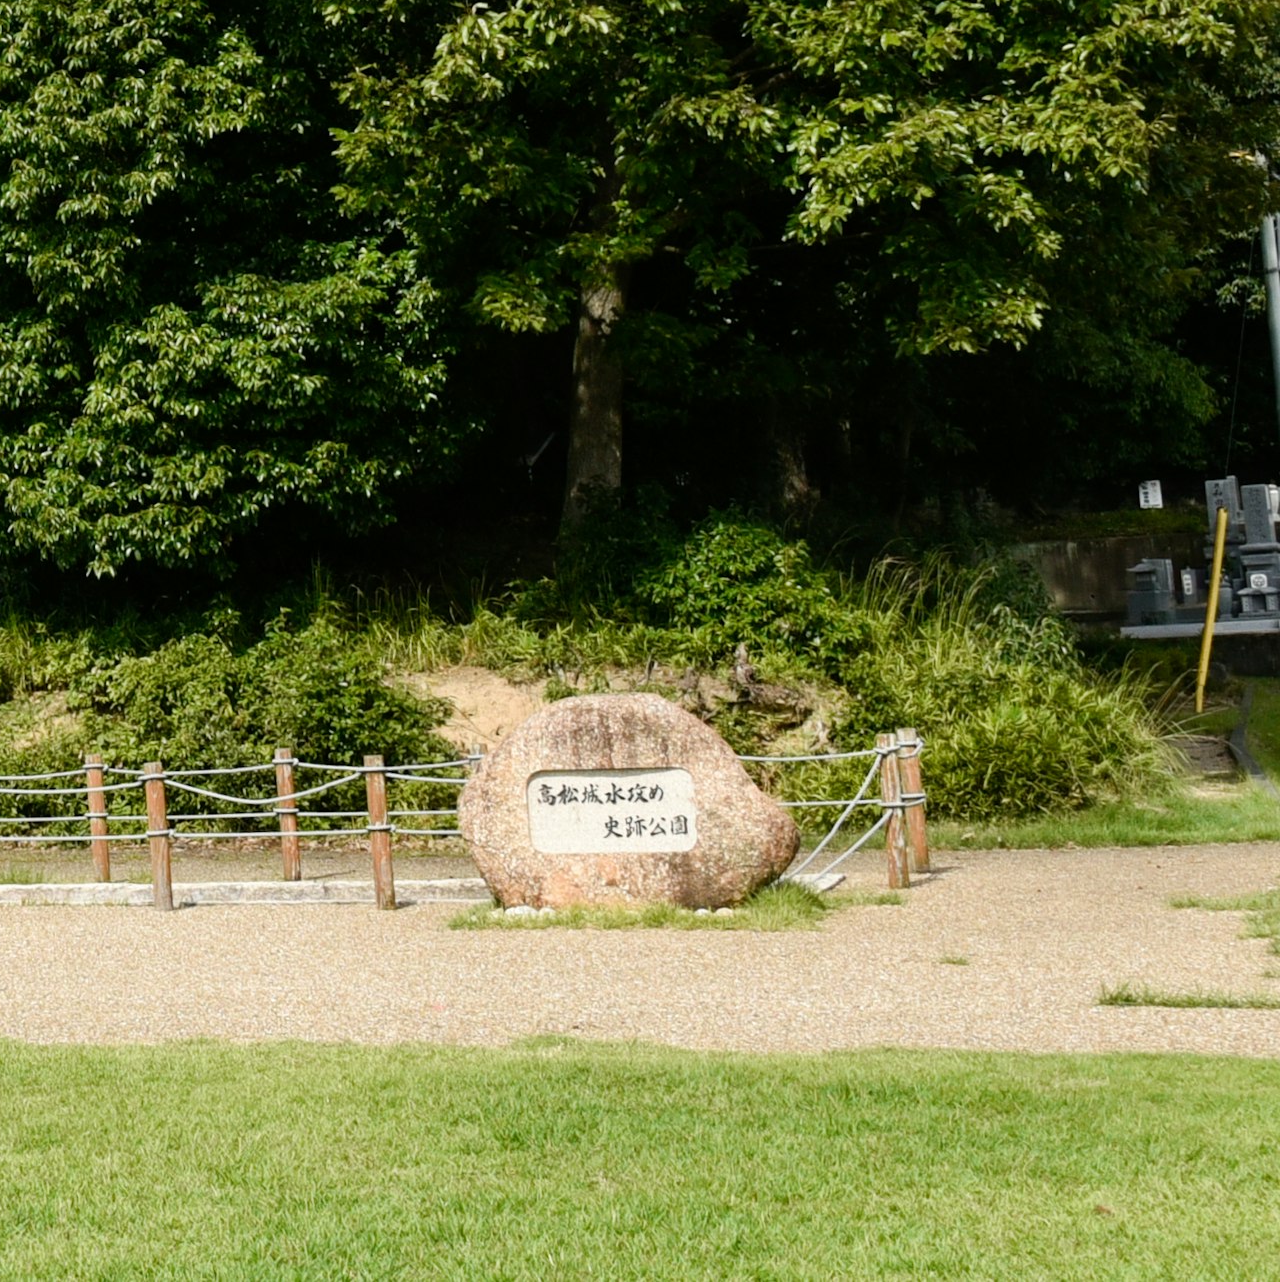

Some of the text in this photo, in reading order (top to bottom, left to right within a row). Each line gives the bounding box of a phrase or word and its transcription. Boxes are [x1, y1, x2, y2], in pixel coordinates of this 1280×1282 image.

[537, 782, 665, 806] 高松城水攻め
[603, 815, 689, 839] 史跡公園
